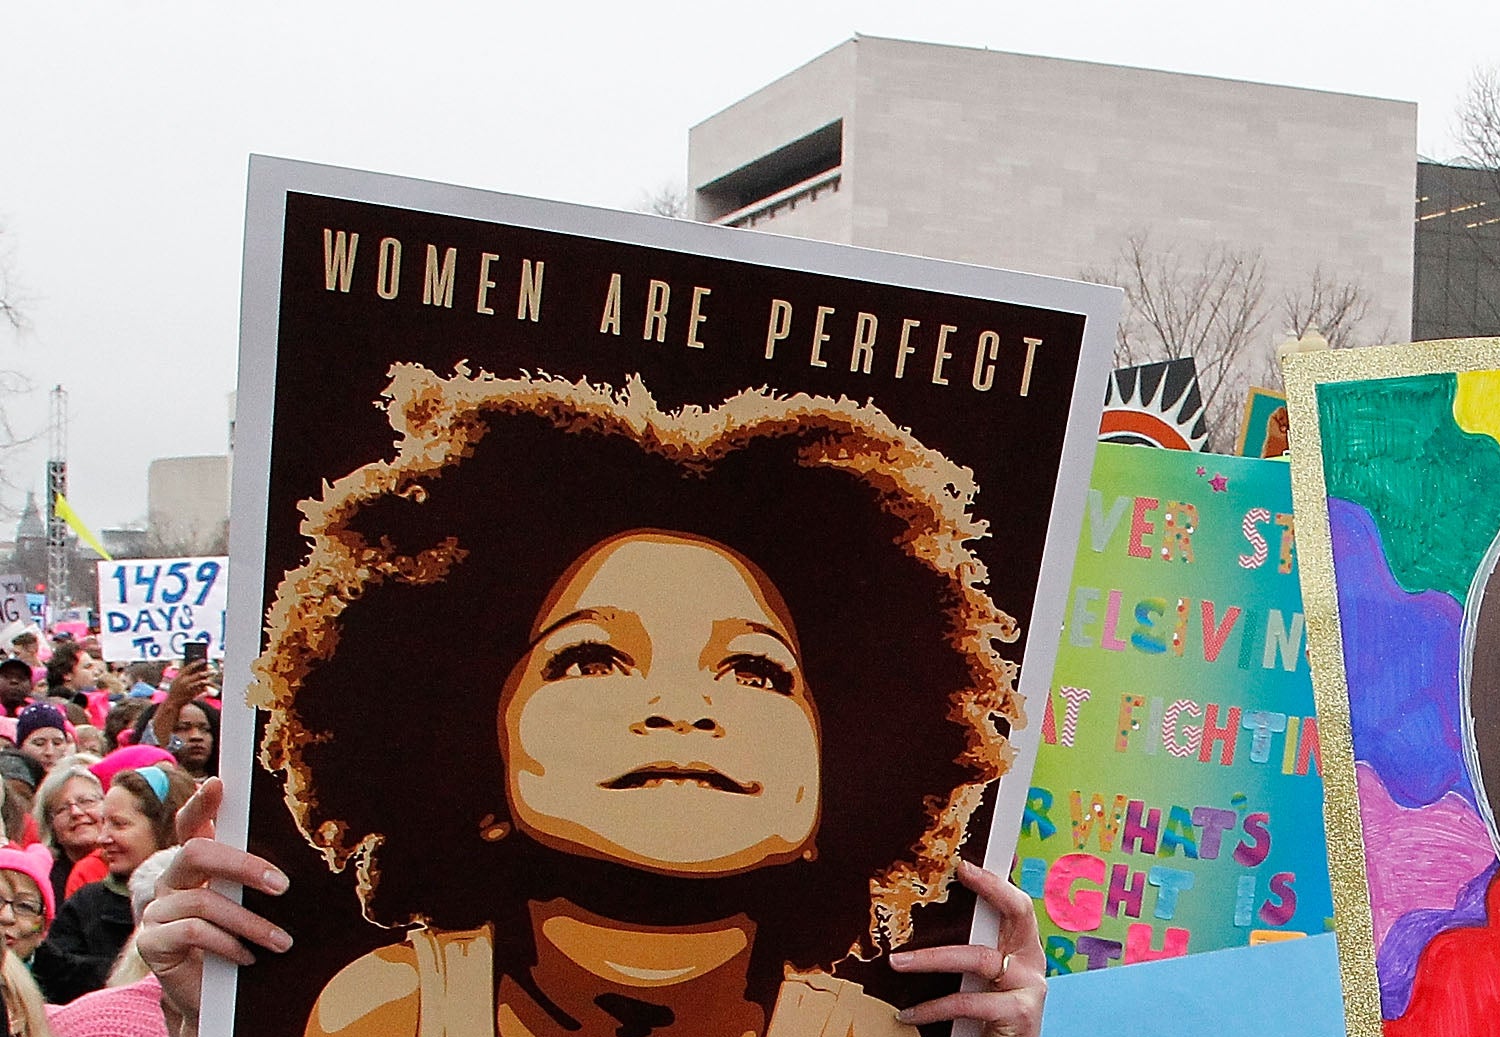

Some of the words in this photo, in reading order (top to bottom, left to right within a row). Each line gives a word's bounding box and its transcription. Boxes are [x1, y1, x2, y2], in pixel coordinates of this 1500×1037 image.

[323, 228, 545, 323] WOMEN
[599, 272, 711, 349] ARE
[764, 298, 1043, 397] PERFECT
[106, 604, 194, 634] DAYS
[112, 561, 221, 606] 1459
[1069, 790, 1273, 868] WHAT'S
[1011, 853, 1195, 932] IGHT
[1234, 871, 1297, 927] IS
